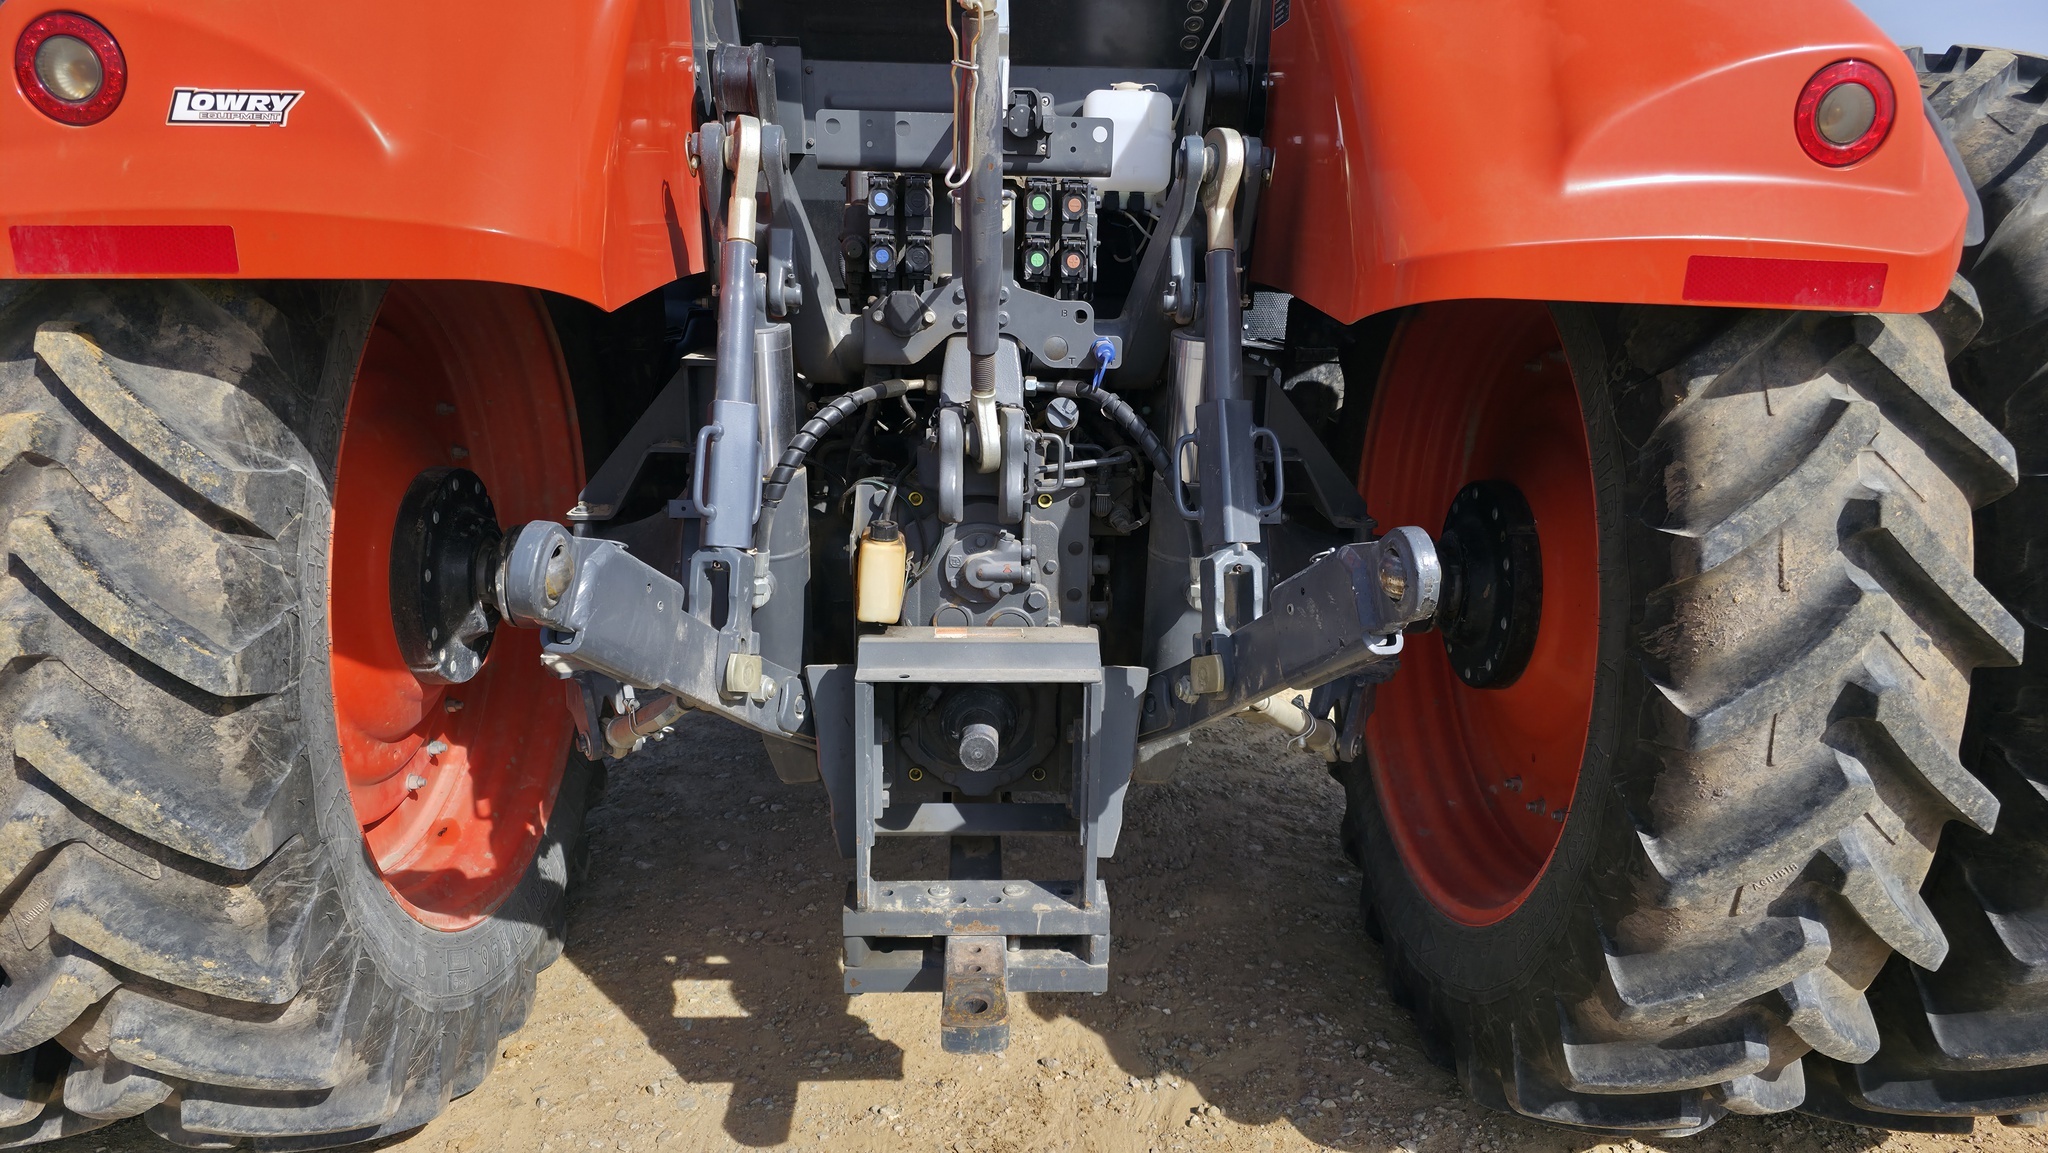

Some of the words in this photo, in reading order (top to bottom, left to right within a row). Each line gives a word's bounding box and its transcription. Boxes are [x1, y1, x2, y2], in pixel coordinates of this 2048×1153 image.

[171, 92, 294, 120] LOWRY
[199, 112, 281, 120] EQUIPMENT
[1062, 309, 1068, 317] B
[1068, 357, 1076, 365] T
[1752, 863, 1799, 891] AGRIBIB
